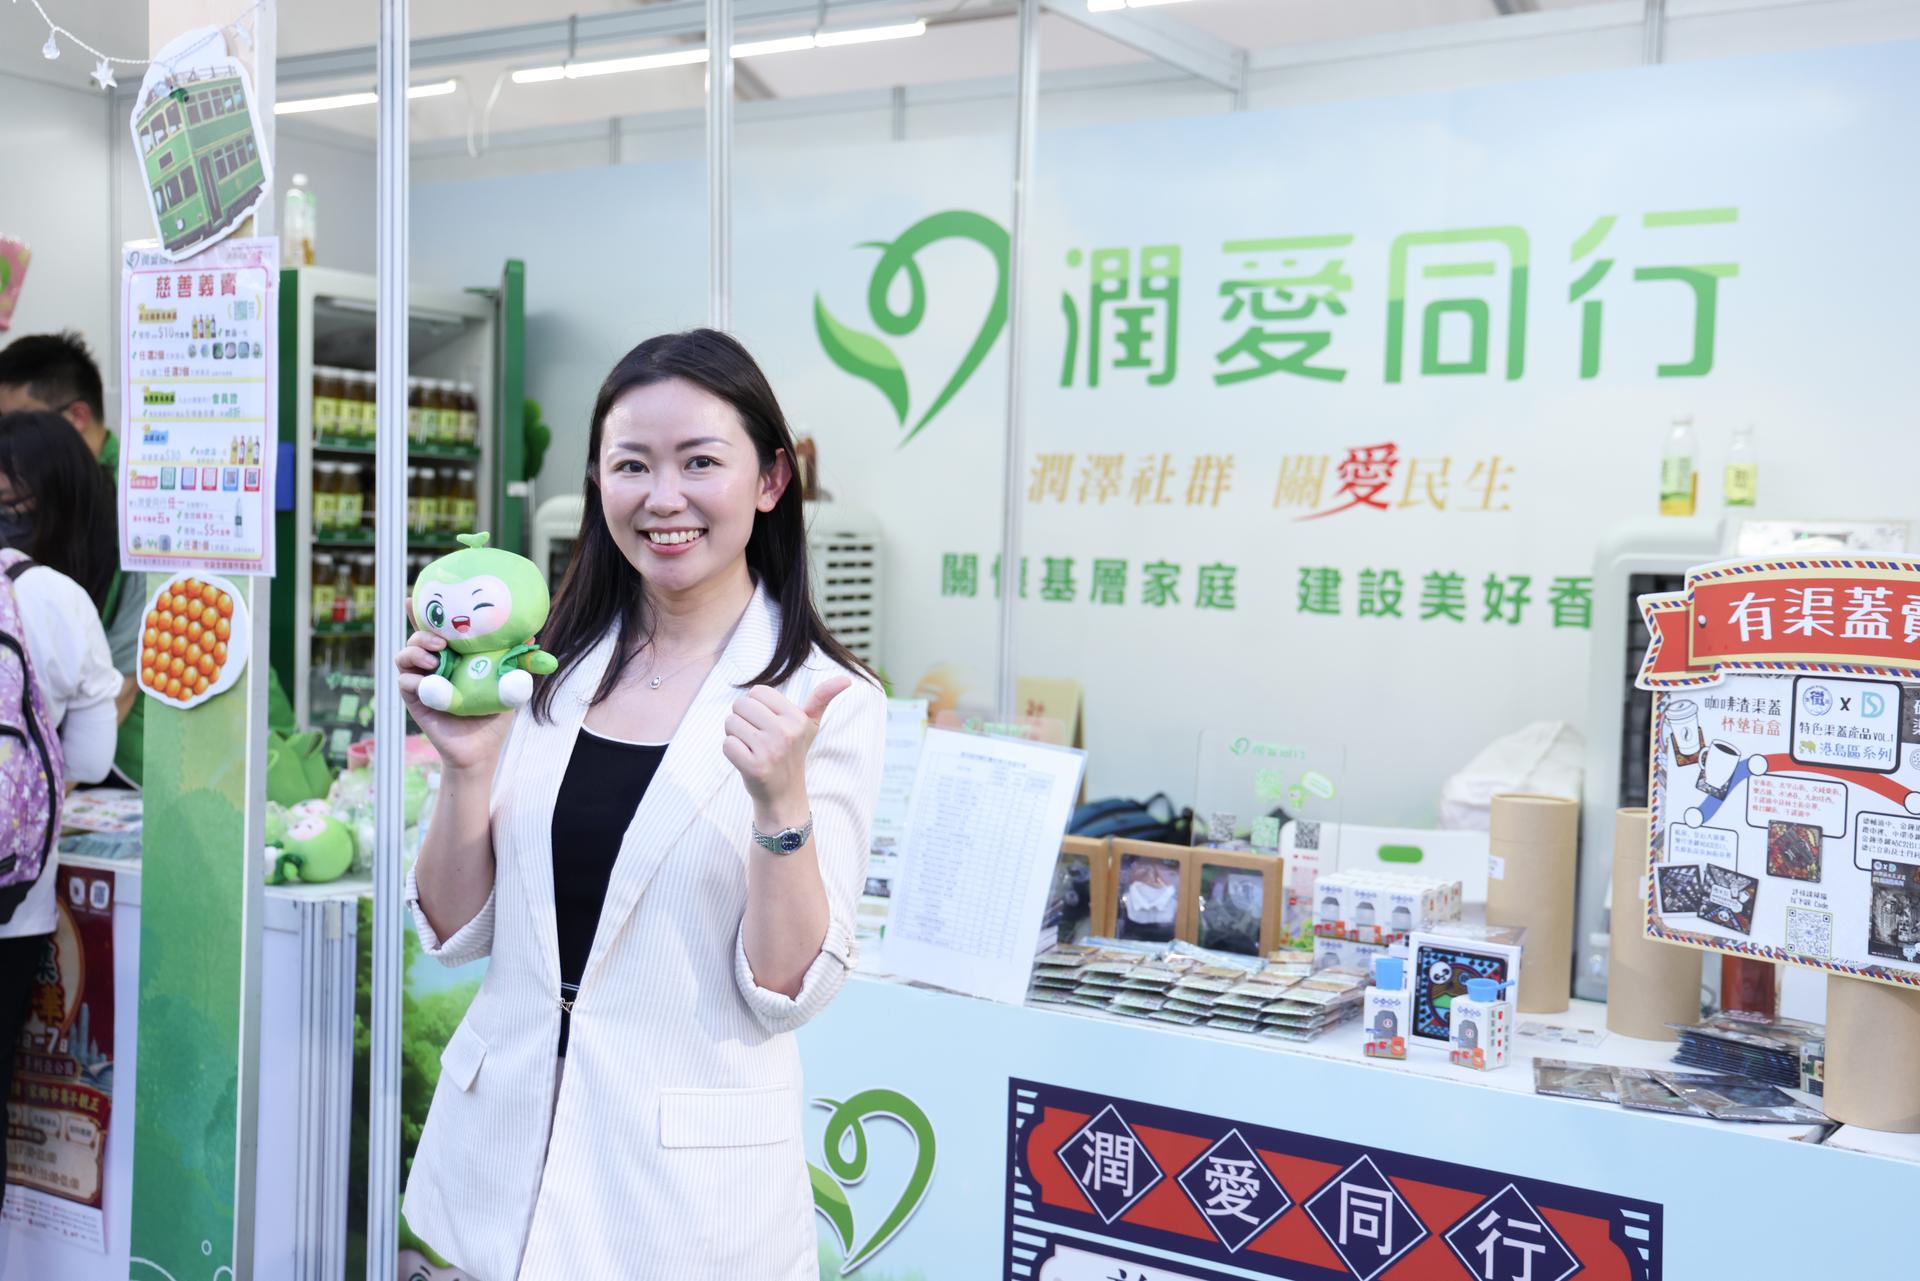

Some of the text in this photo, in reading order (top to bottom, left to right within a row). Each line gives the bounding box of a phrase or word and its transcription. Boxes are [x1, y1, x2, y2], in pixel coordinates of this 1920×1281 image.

[1058, 207, 1740, 391] 潤愛同行
[1027, 442, 1517, 523] 潤澤社群 關愛民生
[1704, 695, 1781, 716] 咖啡渣渠蓋
[1721, 715, 1781, 736] 杯墊盲盒
[1820, 742, 1892, 761] 港島區系列
[1081, 1129, 1547, 1281] 潤愛同行
